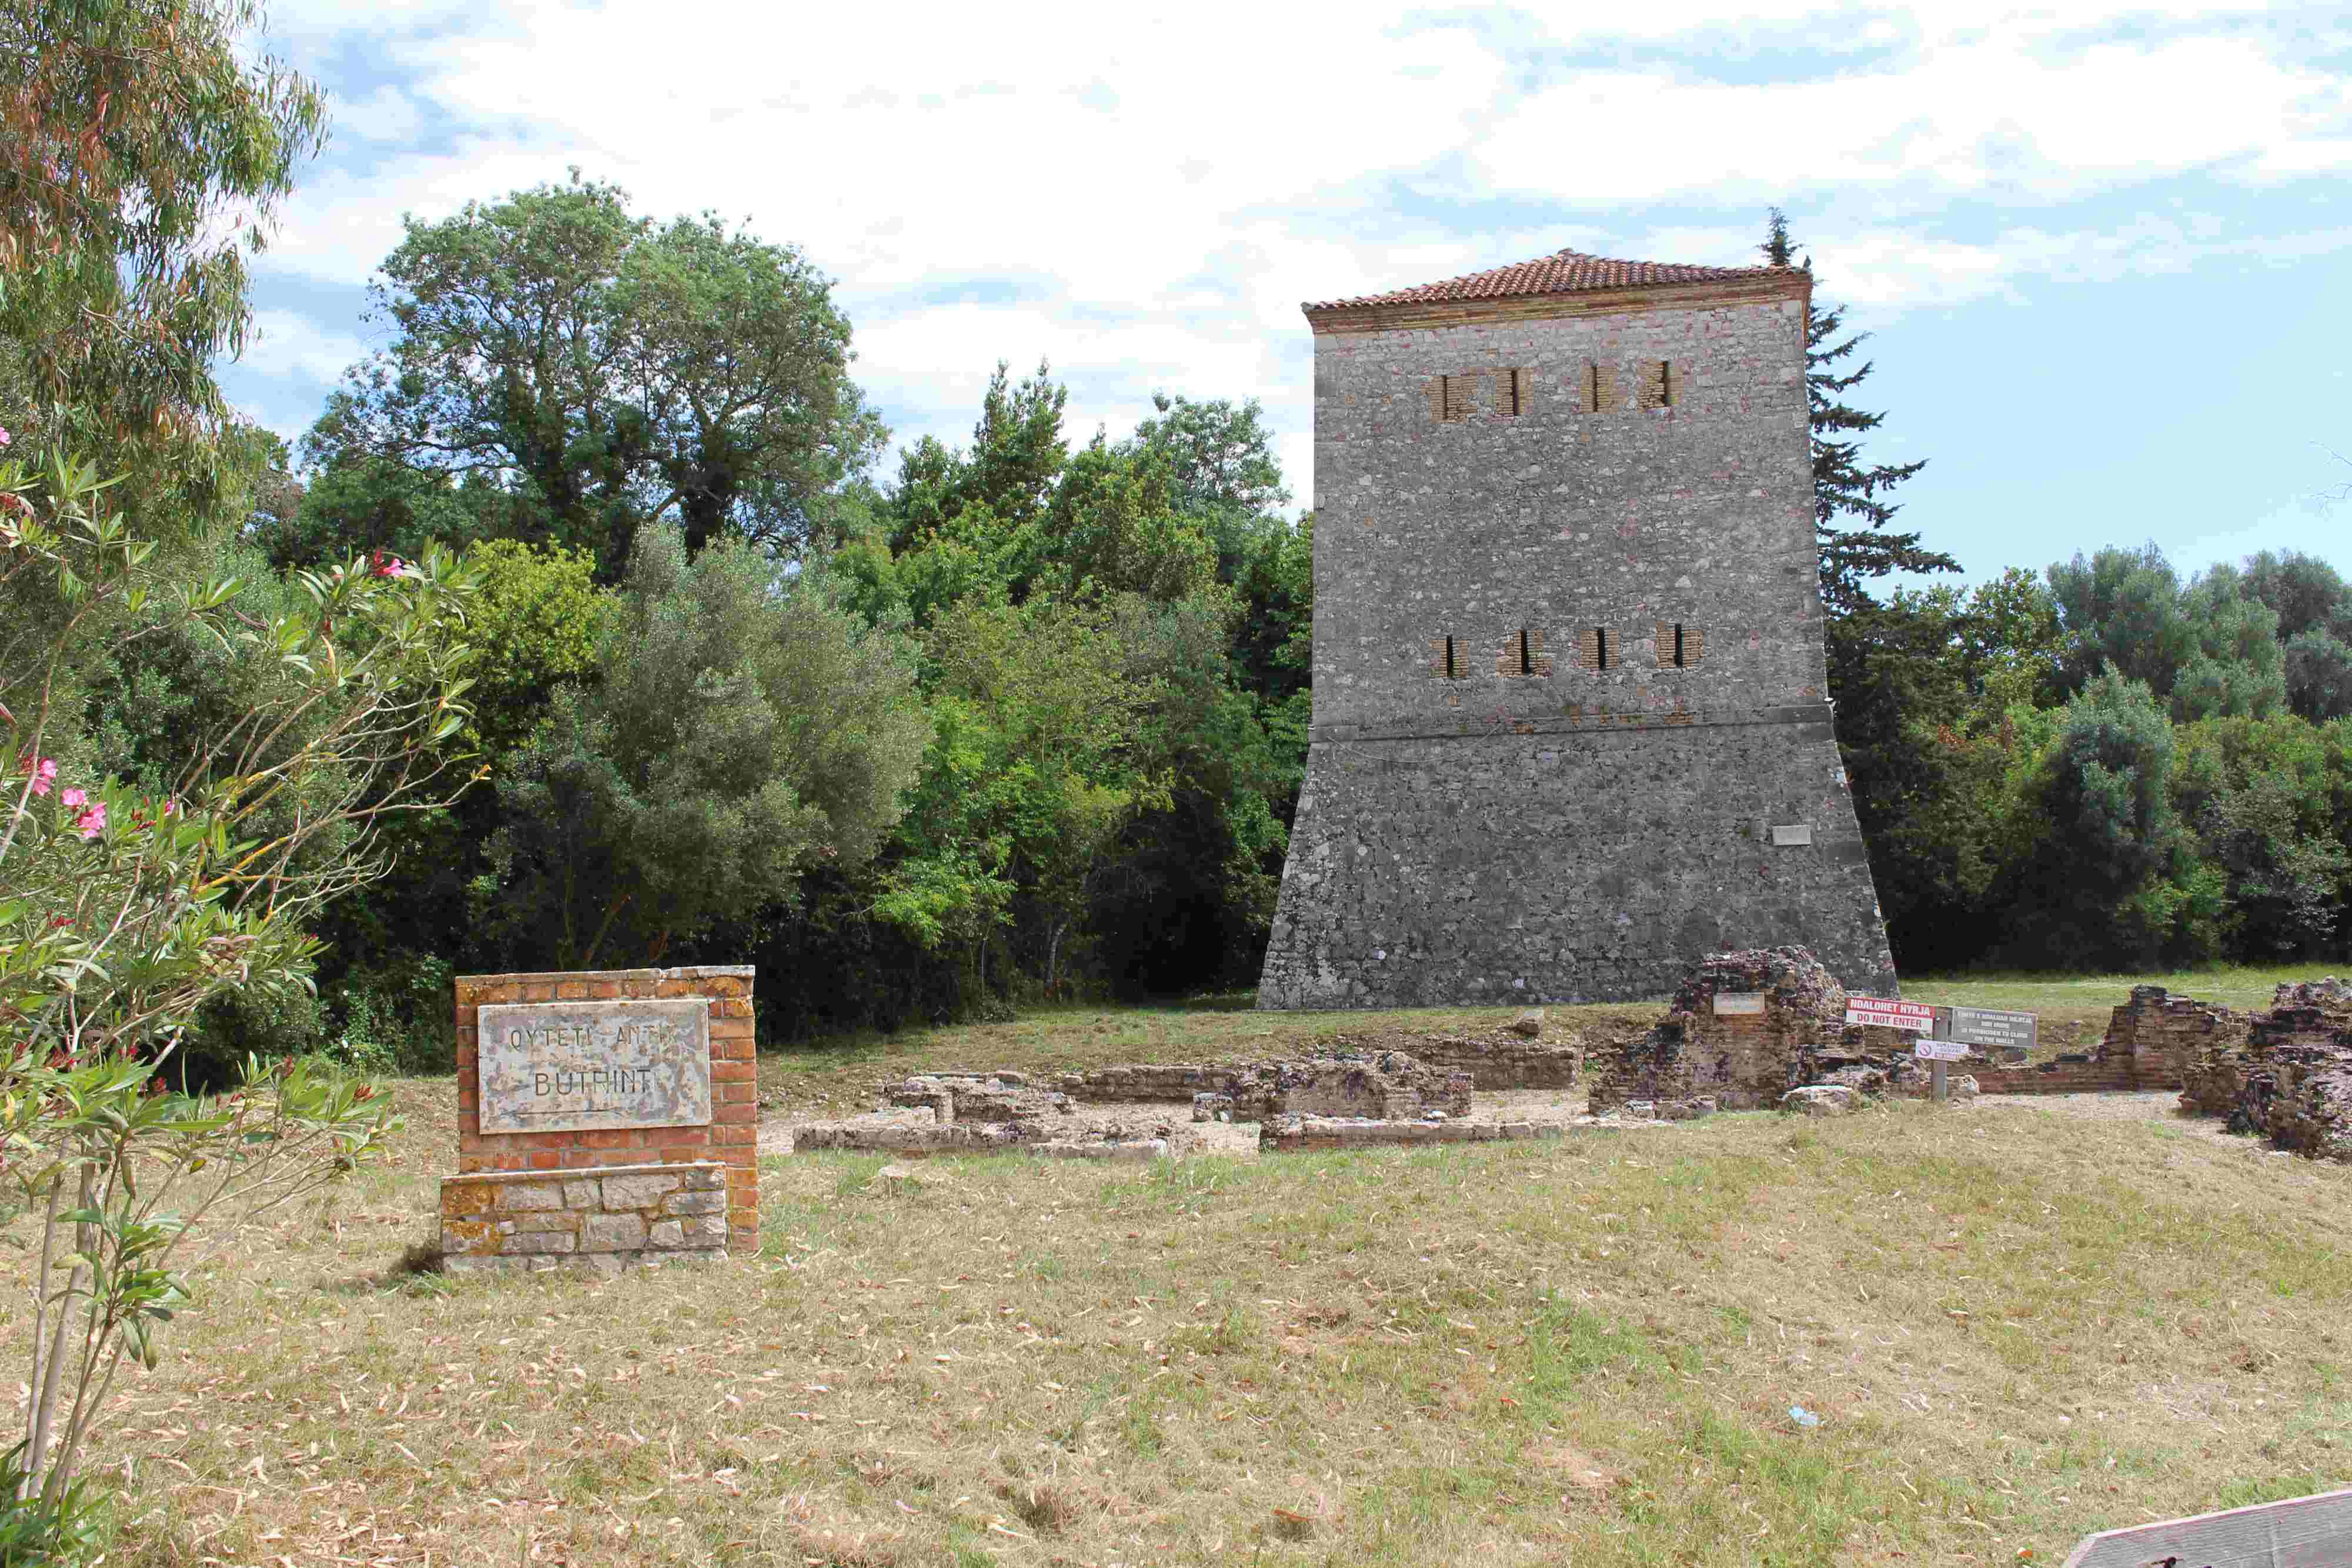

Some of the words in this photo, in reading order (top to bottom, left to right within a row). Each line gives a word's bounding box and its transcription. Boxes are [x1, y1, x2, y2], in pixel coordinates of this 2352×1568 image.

[1850, 999, 1898, 1013] NDALOHET
[1899, 1004, 1930, 1015] HYRJA
[1857, 1013, 1869, 1022] DO
[1872, 1015, 1890, 1025] NOT
[1893, 1017, 1922, 1027] ENTER
[510, 1027, 593, 1049] QYTETI
[534, 1069, 651, 1096] BUTRINT
